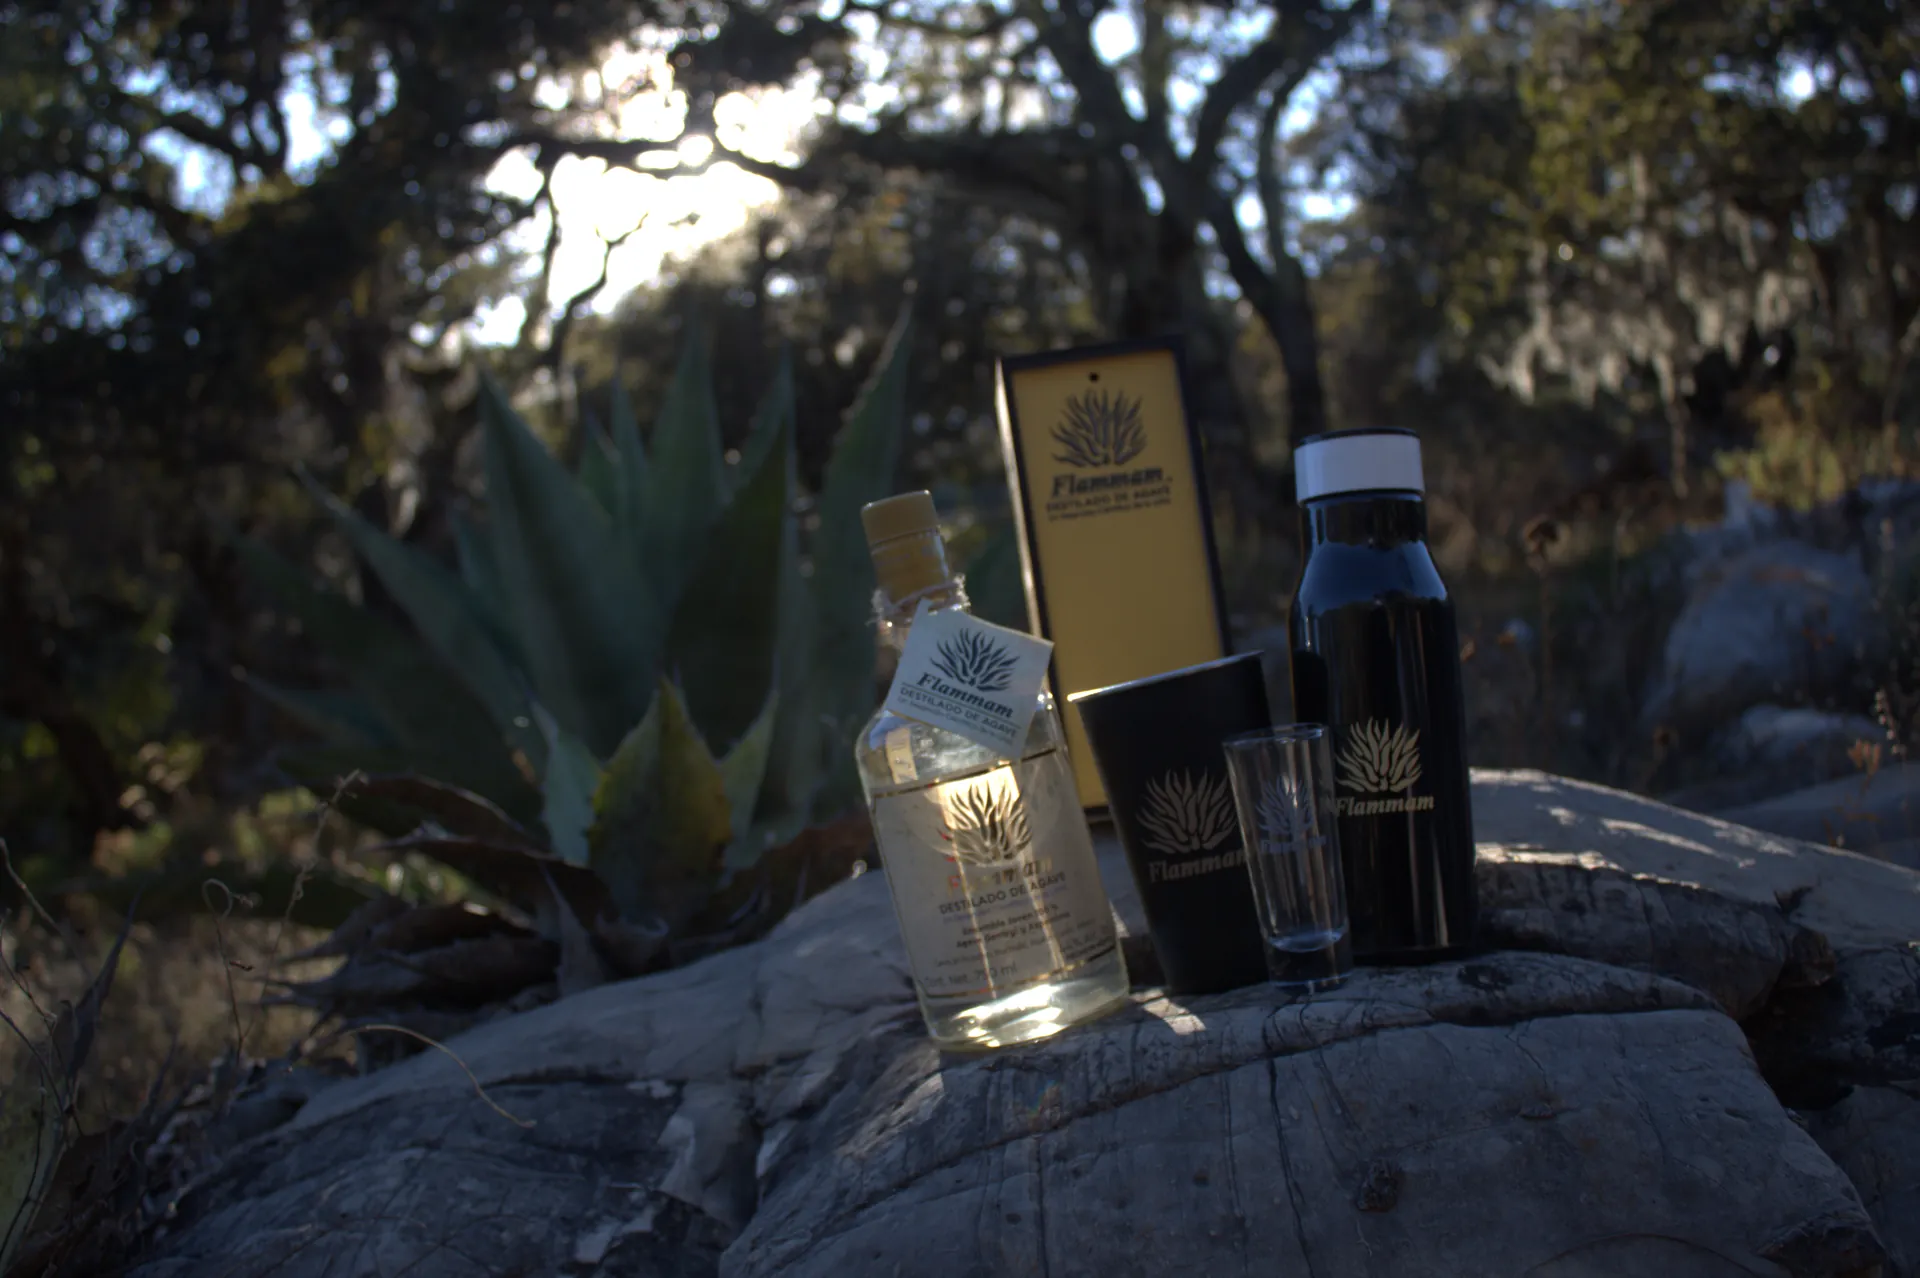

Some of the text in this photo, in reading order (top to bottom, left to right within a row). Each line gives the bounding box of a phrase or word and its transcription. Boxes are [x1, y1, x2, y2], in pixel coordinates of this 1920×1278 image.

[900, 686, 963, 715] DESTILADO
[964, 710, 981, 720] DE
[982, 717, 1018, 738] AGAVE
[917, 671, 1014, 719] Flammam
[1336, 795, 1434, 817] Flammam
[1009, 884, 1026, 898] DE
